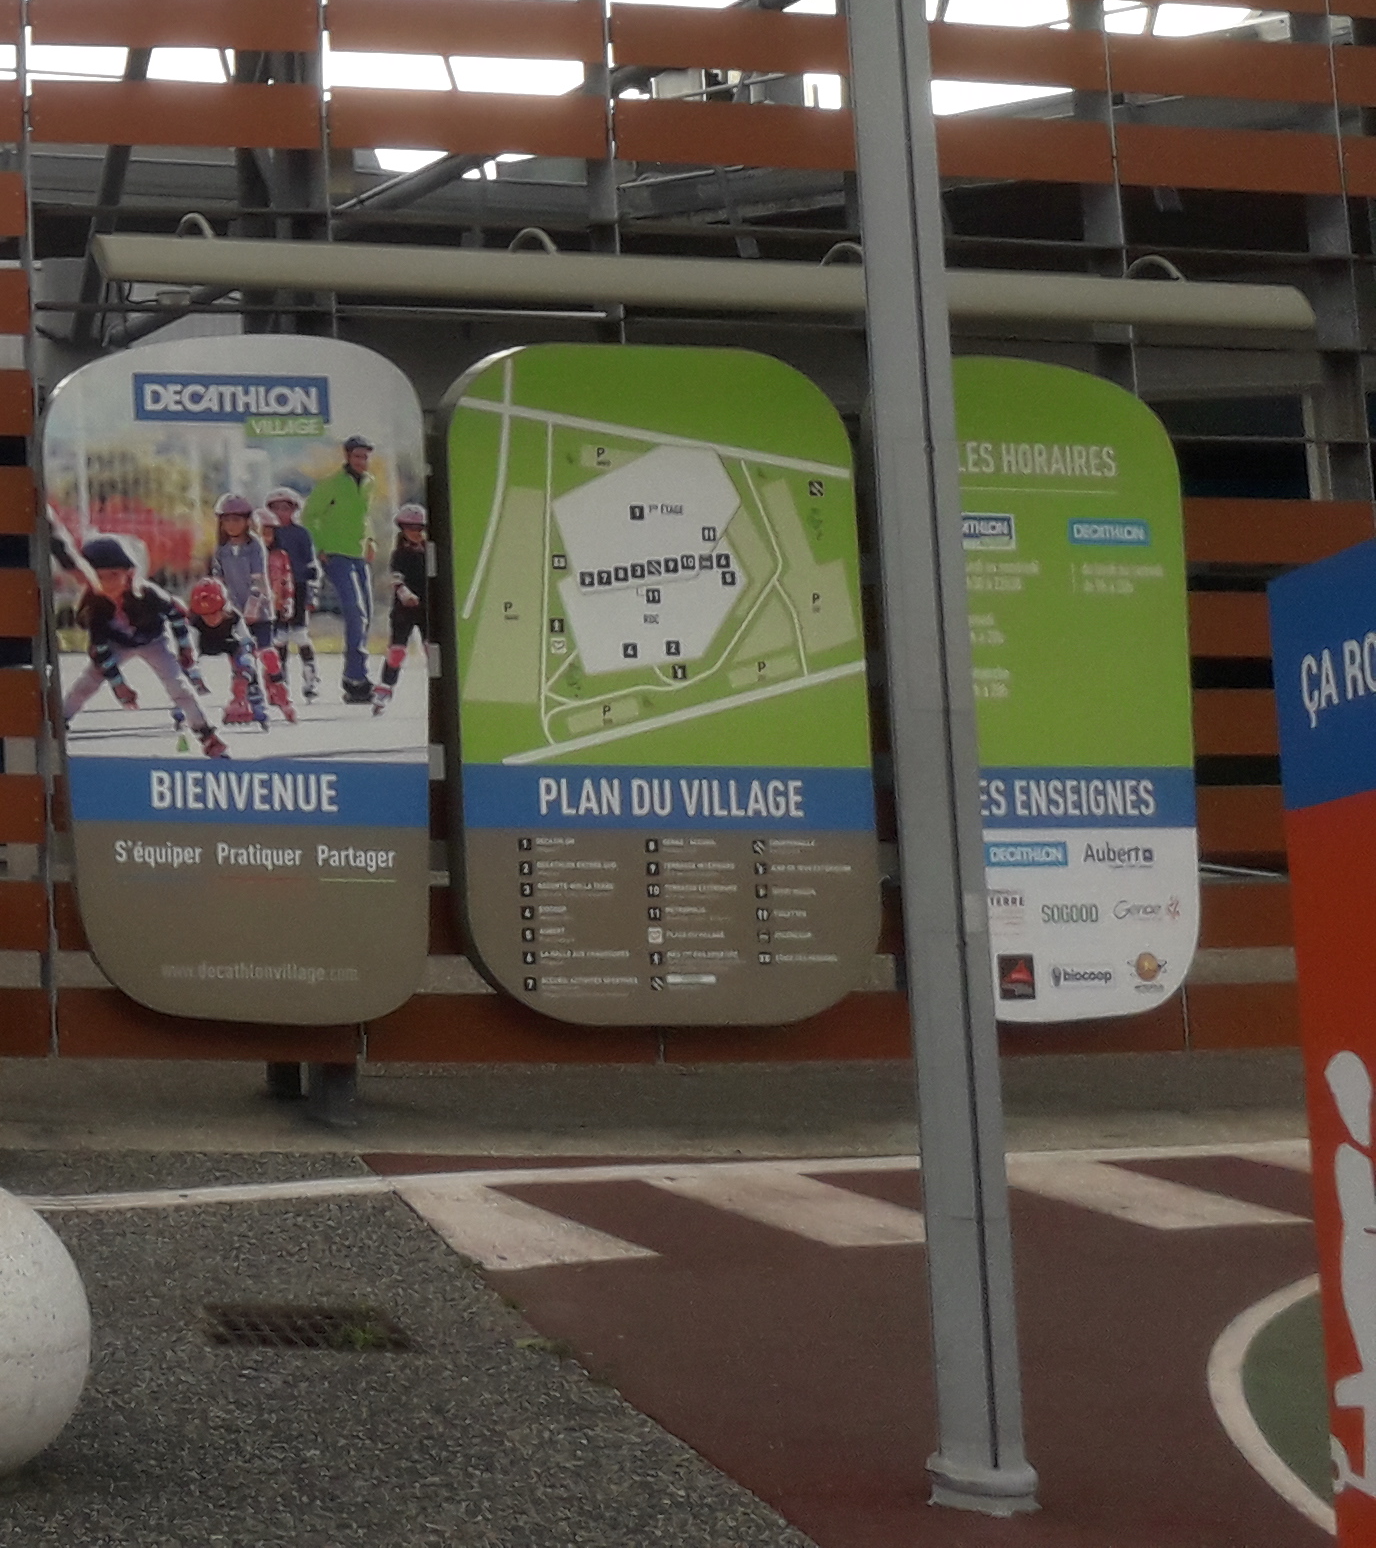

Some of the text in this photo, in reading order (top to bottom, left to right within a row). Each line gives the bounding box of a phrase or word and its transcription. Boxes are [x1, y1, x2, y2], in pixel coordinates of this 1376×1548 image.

[143, 383, 320, 415] DECATHLON
[250, 419, 320, 435] VILLAGE
[959, 442, 1119, 478] ES HORAIRES
[1073, 523, 1146, 541] DECATHLON
[1301, 647, 1340, 729] ÇA
[149, 769, 340, 813] BIENVENUE
[538, 777, 805, 818] PLAN DU VILLAGE
[979, 778, 1157, 817] ES ENSEIGNES
[114, 840, 397, 874] S'équiper Pratiquer Partager
[990, 841, 1140, 864] DECATHLON Aubert
[1041, 903, 1099, 923] SOGOOD
[161, 962, 359, 984] www.decathlonvillage.com
[1063, 968, 1112, 984] biocoop
